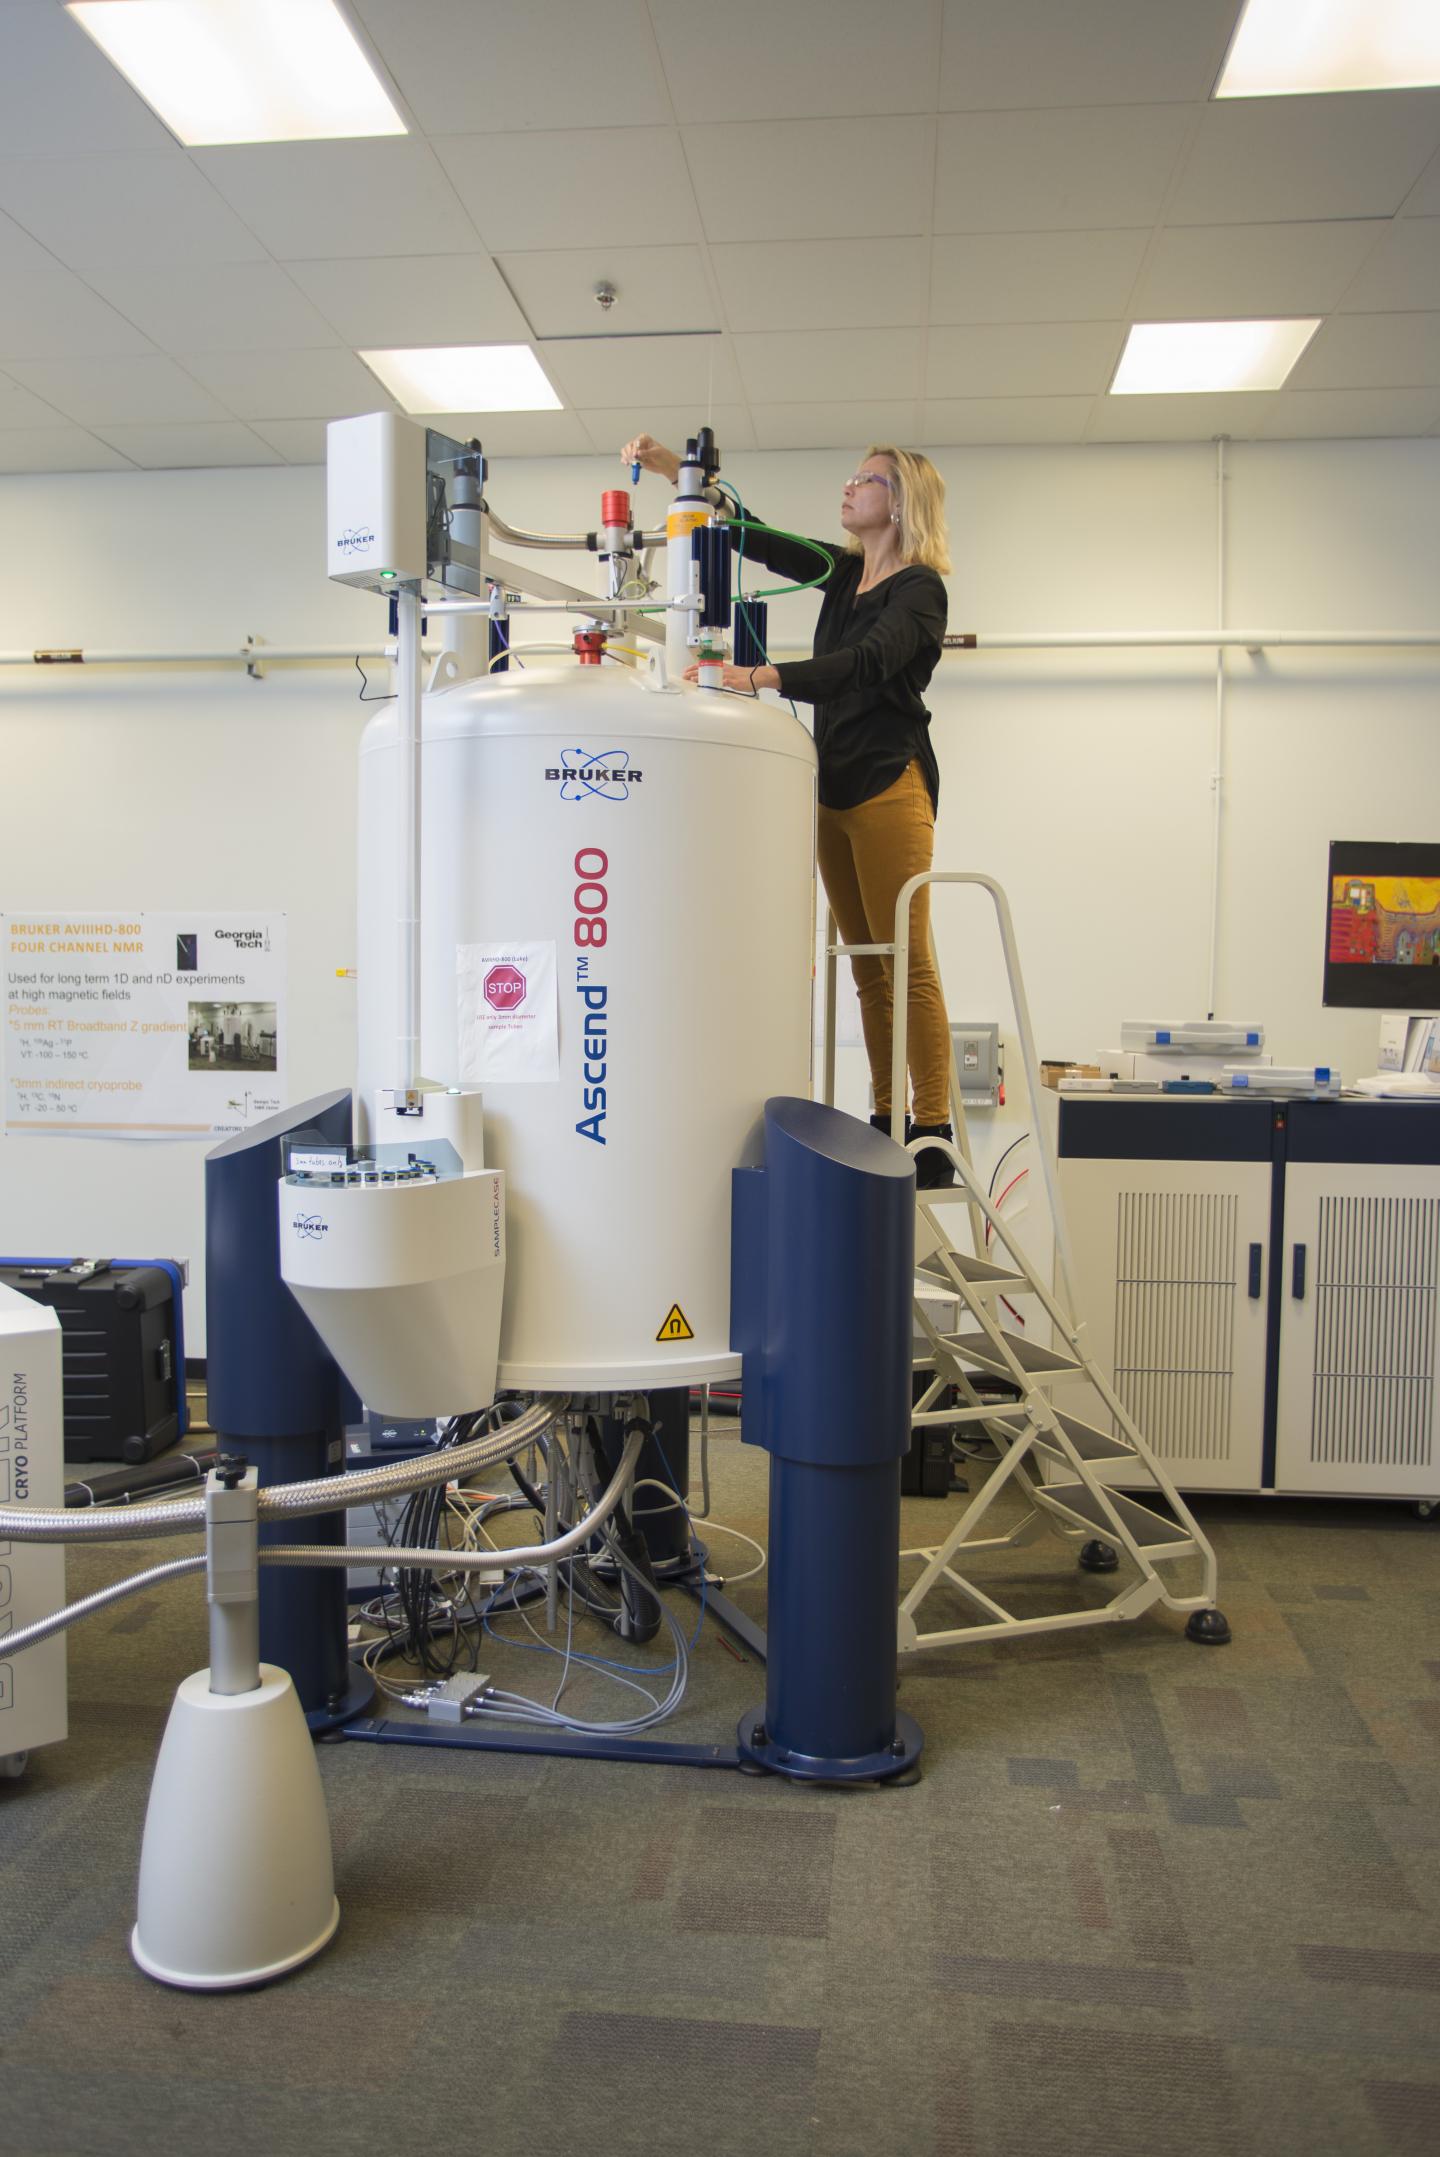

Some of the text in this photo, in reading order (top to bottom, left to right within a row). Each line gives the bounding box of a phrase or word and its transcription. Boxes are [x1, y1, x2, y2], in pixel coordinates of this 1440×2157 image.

[337, 535, 375, 547] BRUKER
[545, 768, 643, 783] BRUKER
[574, 847, 609, 948] 800
[10, 924, 141, 936] BRUKER AVIIIHD-800
[215, 929, 263, 940] Georgia
[10, 942, 144, 953] FOUR CHANNEL NMR
[234, 940, 263, 949] Tech
[8, 972, 246, 987] Used for long term 1D and nD experiments
[488, 982, 521, 994] STOP
[8, 988, 131, 1003] at high magnetic fields
[24, 1022, 44, 1032] mm
[48, 1020, 64, 1031] RT
[68, 1020, 127, 1033] Broadband
[130, 1020, 139, 1032] Z
[141, 1021, 188, 1034] gradient
[45, 1078, 85, 1089] indirect
[88, 1079, 143, 1092] cryoprobe
[292, 1221, 329, 1232] BRUKER
[13, 1372, 29, 1500] CRYO PLATFORM
